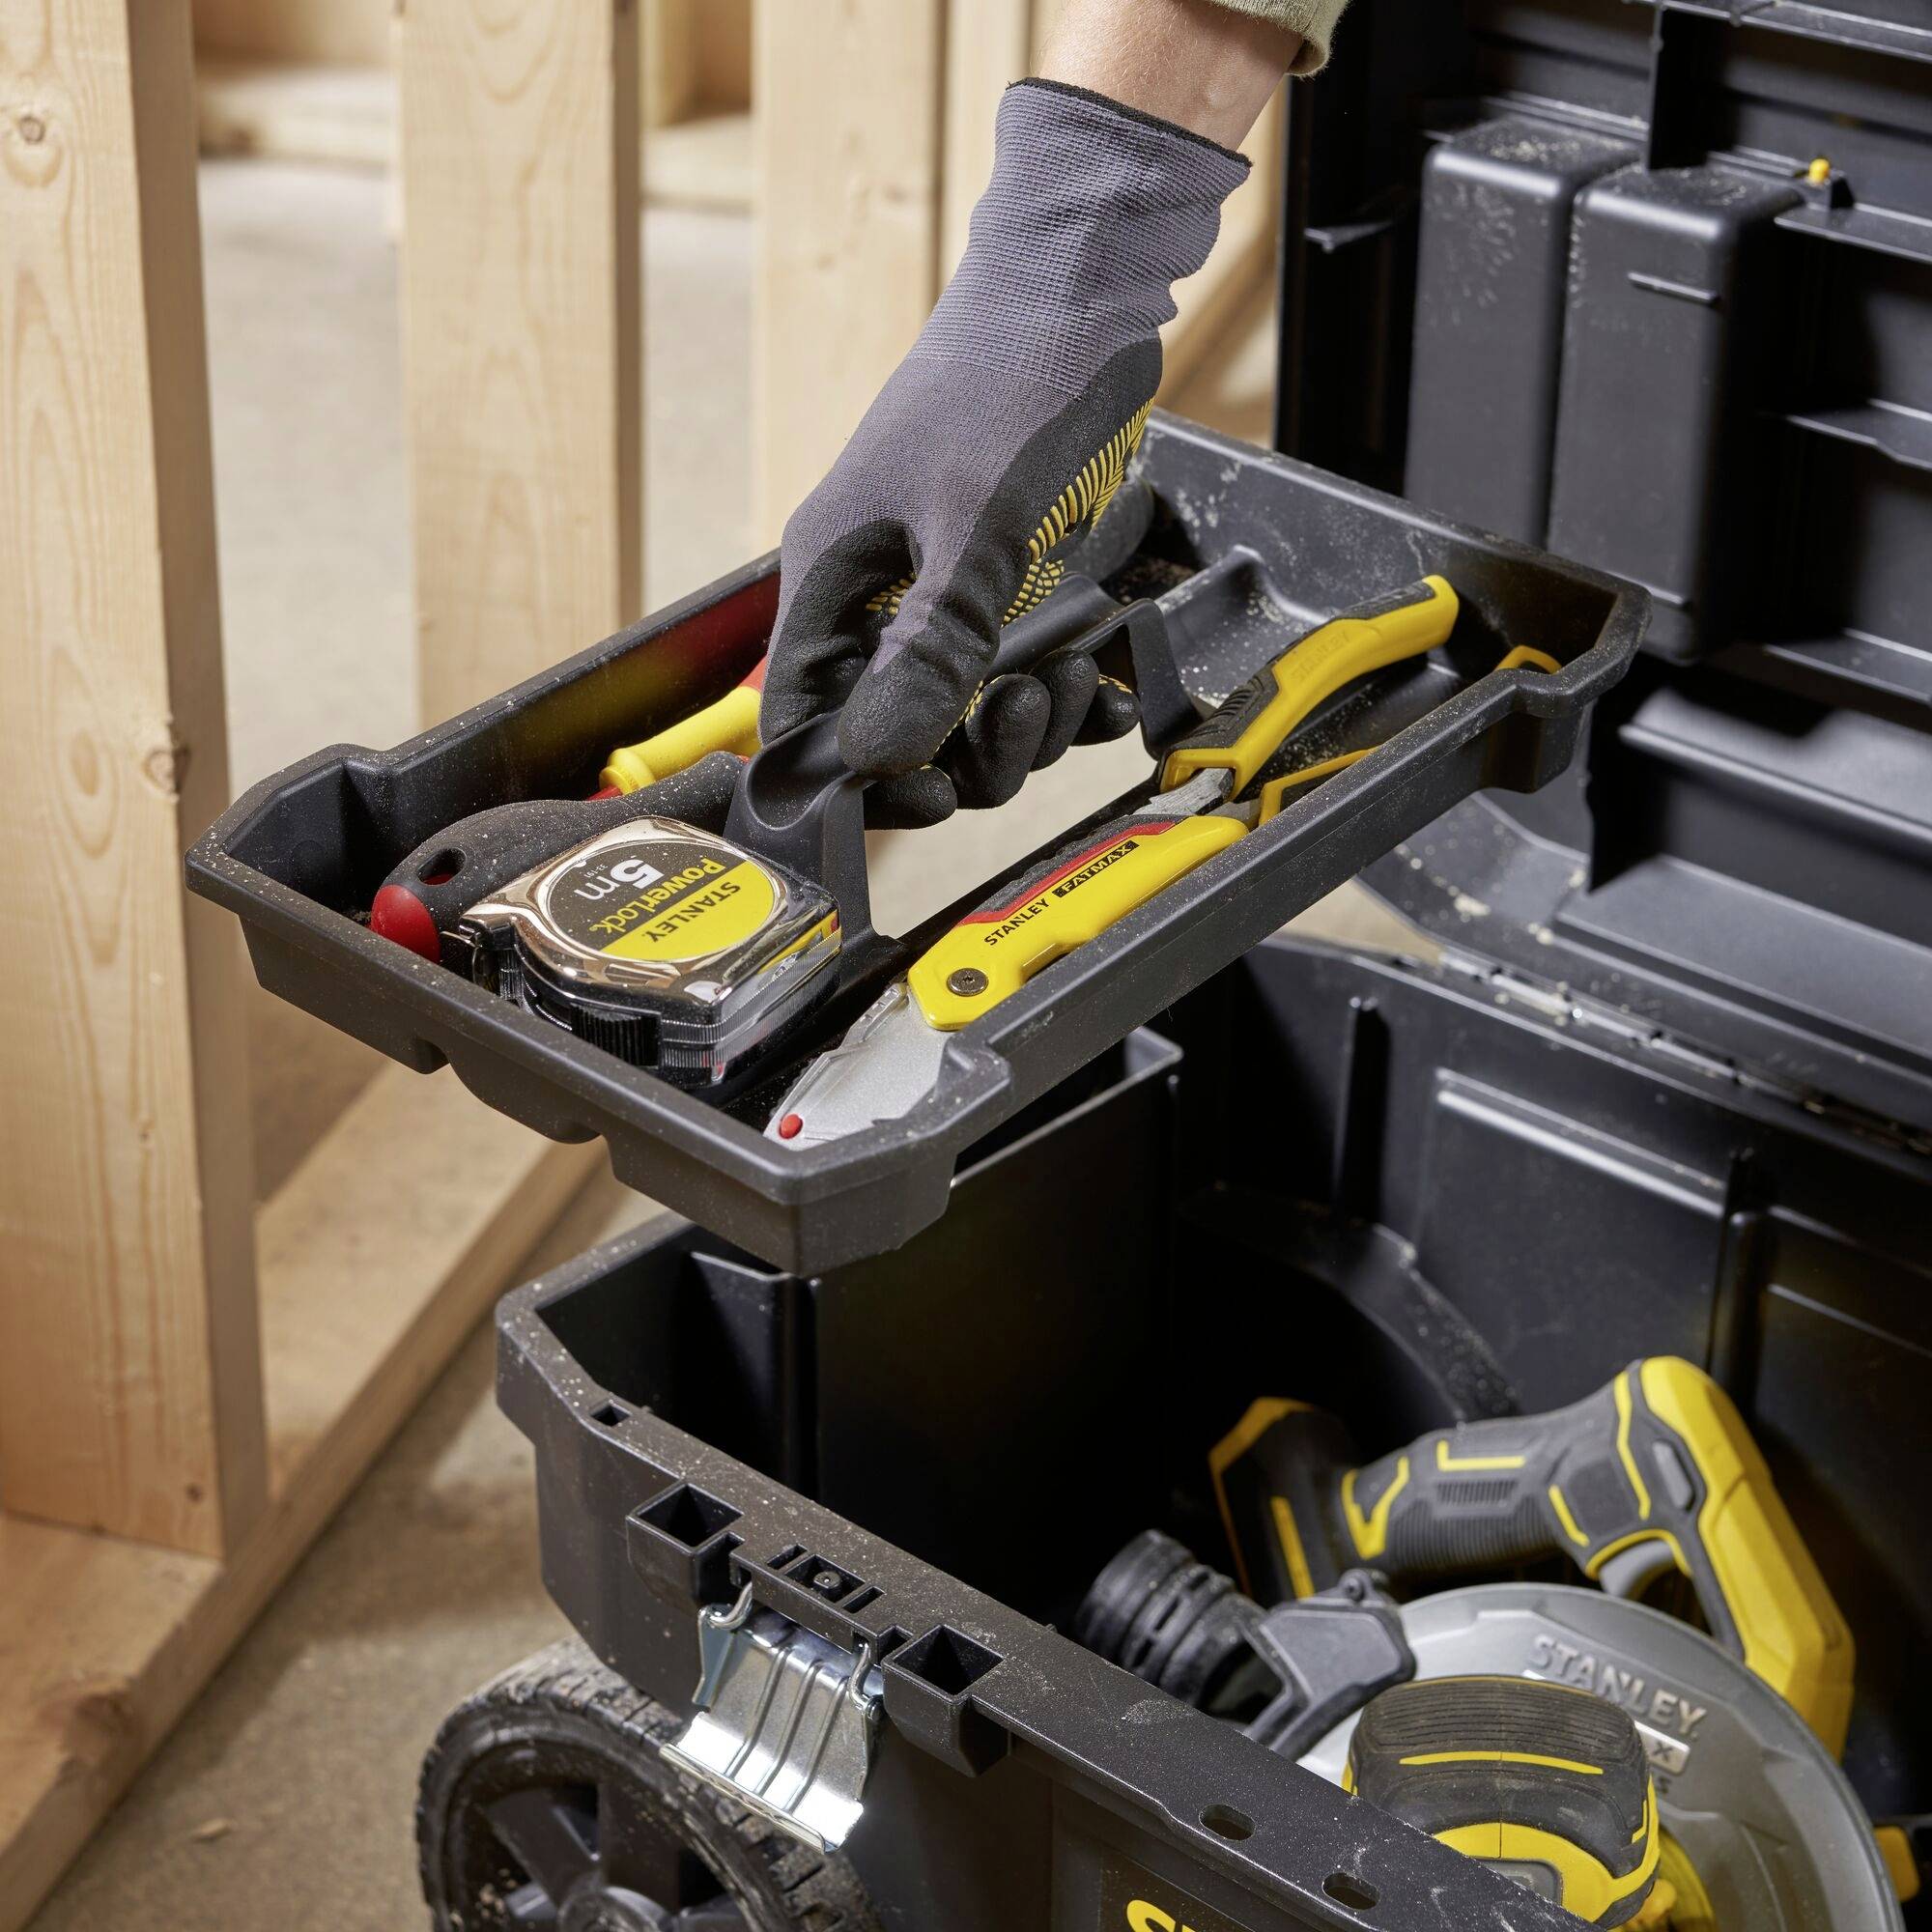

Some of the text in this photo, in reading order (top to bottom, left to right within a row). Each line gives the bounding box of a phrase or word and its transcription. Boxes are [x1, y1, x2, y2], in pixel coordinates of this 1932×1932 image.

[573, 858, 665, 900] 5m
[593, 856, 726, 935] PowerLock
[644, 881, 742, 943] STANLEY
[983, 843, 1134, 946] STANLEY FATMAX
[1529, 1634, 1708, 1735] STANLEY
